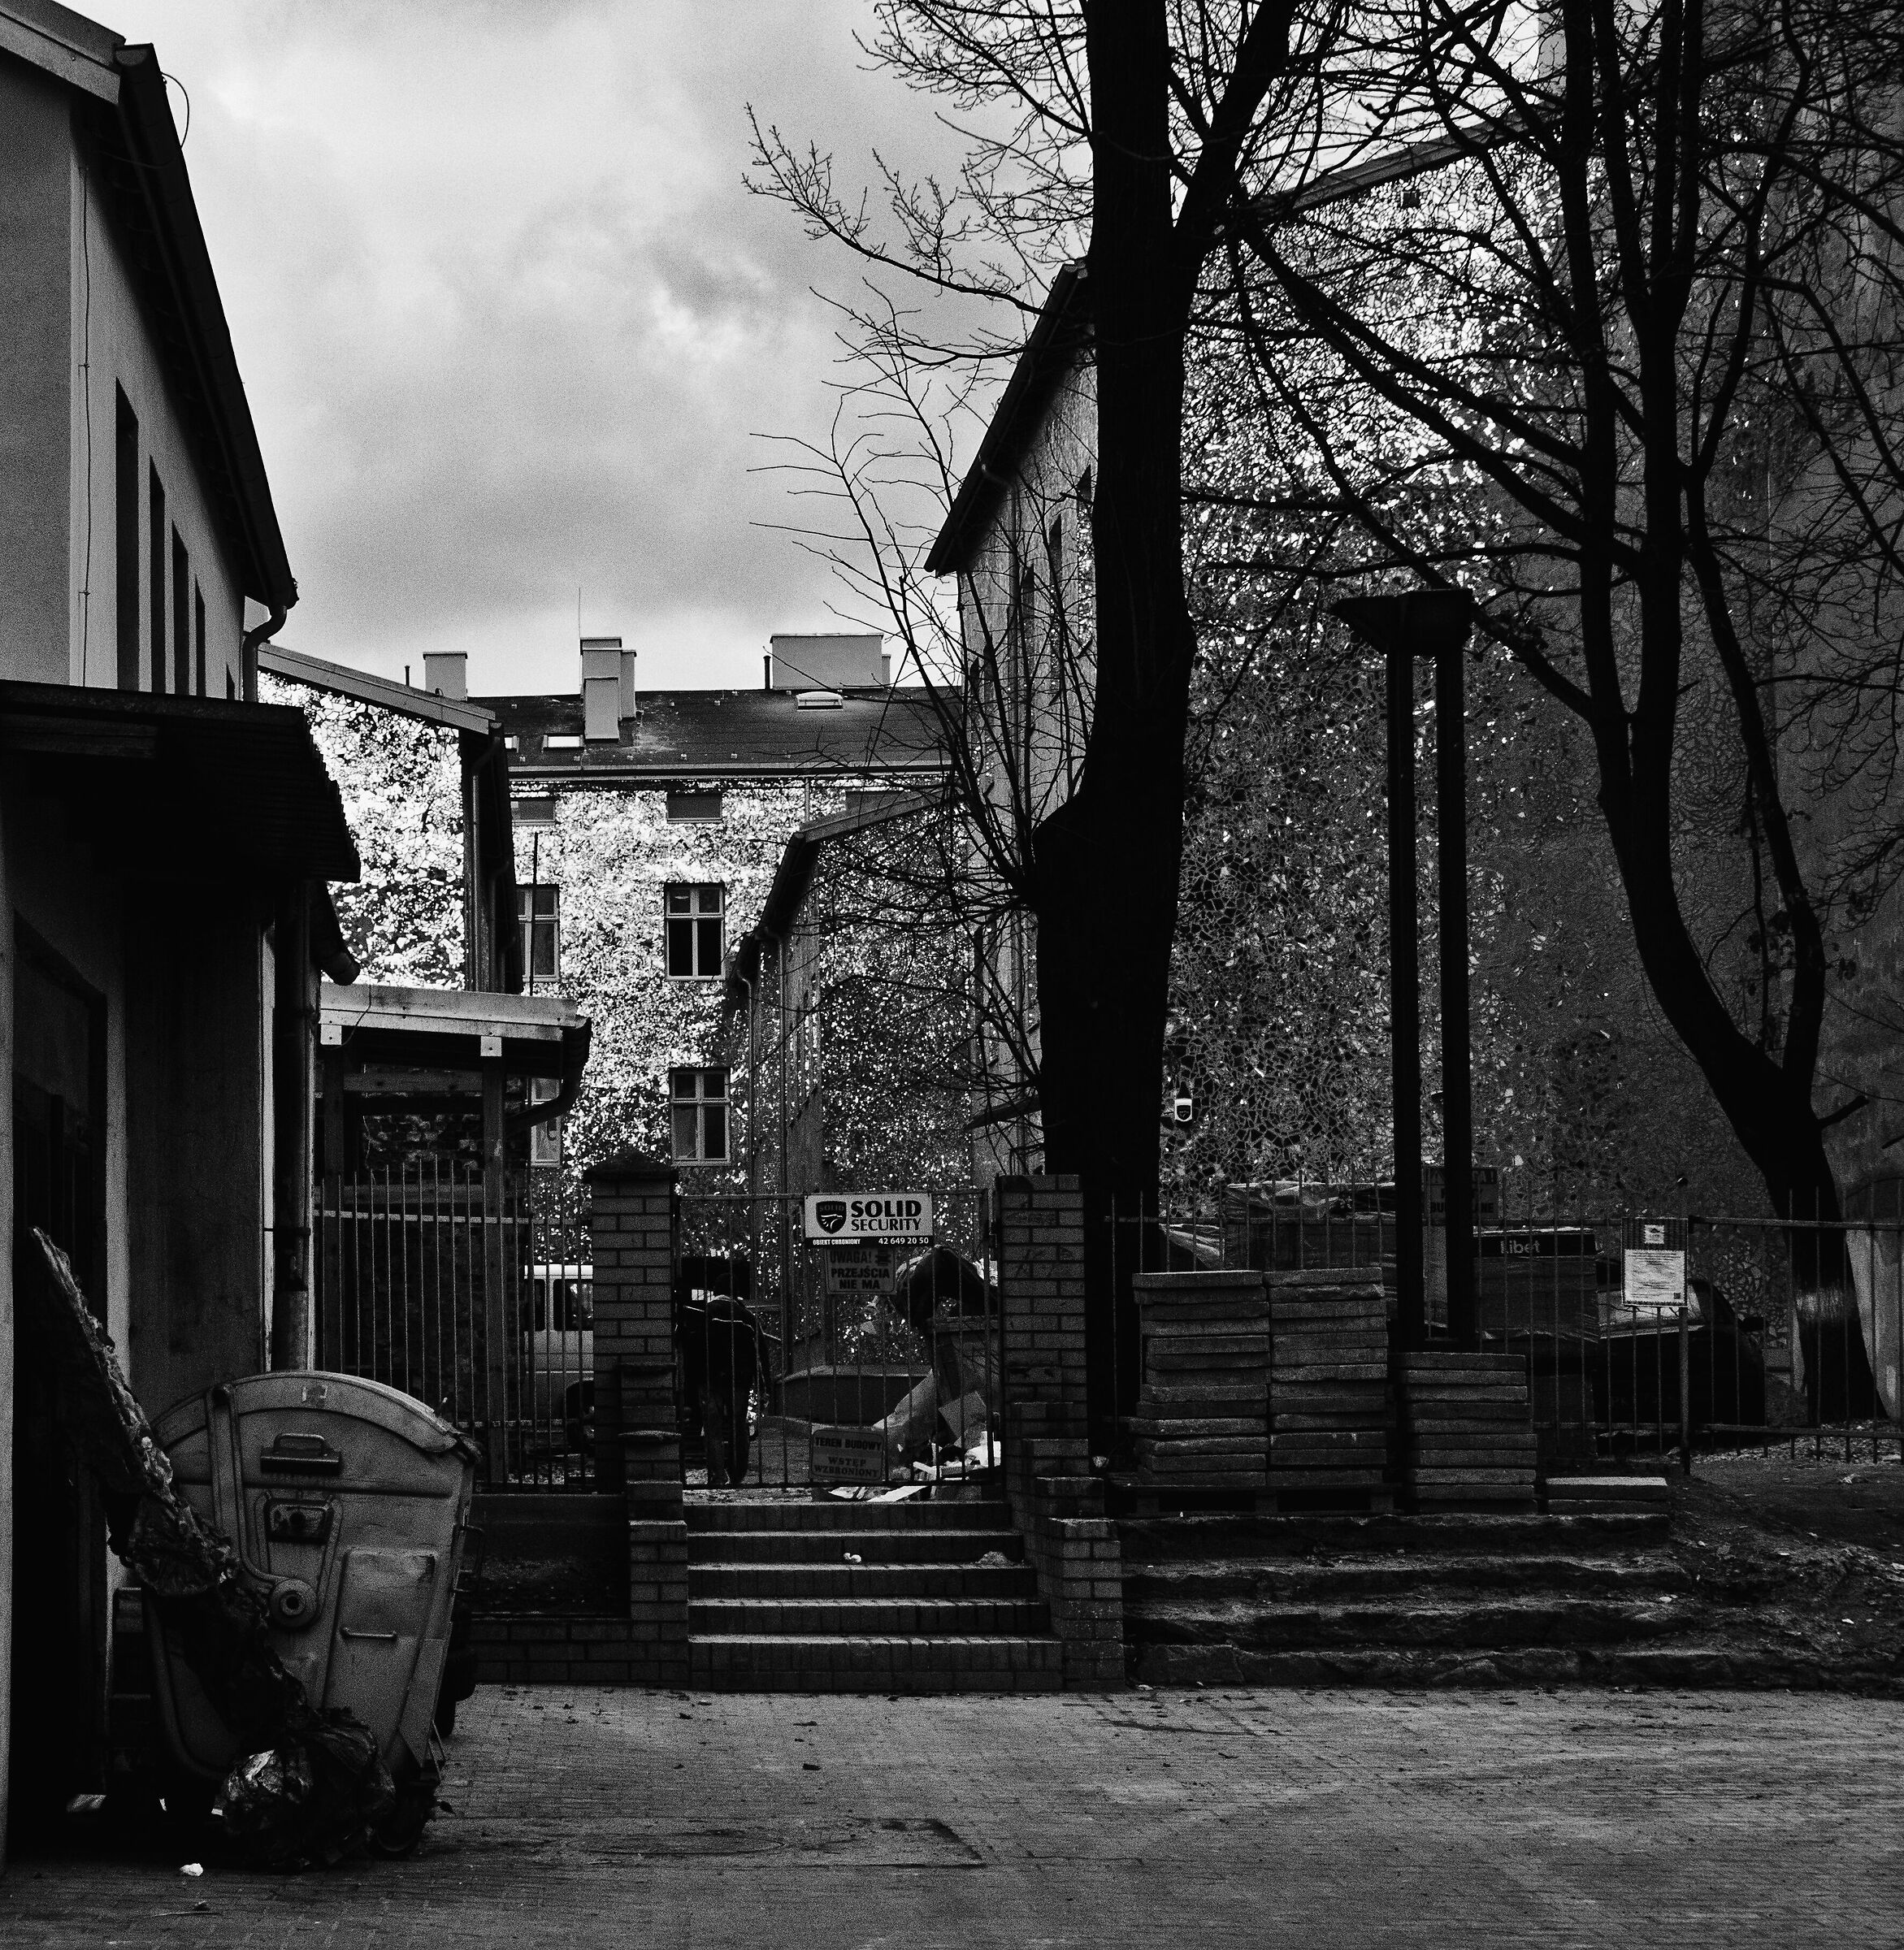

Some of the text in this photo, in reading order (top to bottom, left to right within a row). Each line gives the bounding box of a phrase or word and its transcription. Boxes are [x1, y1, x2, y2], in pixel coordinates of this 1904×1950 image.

[819, 1204, 844, 1212] SOLID
[851, 1200, 922, 1218] SOLID
[851, 1218, 922, 1231] SECURITY
[830, 1250, 872, 1263] UWAGA!
[831, 1265, 890, 1278] PRZEJŚCIA
[839, 1280, 880, 1289] NIE MA
[815, 1437, 882, 1450] TEREN BUDOWY
[828, 1457, 866, 1467] WSTĘP
[813, 1465, 878, 1477] WZBRONIONY
